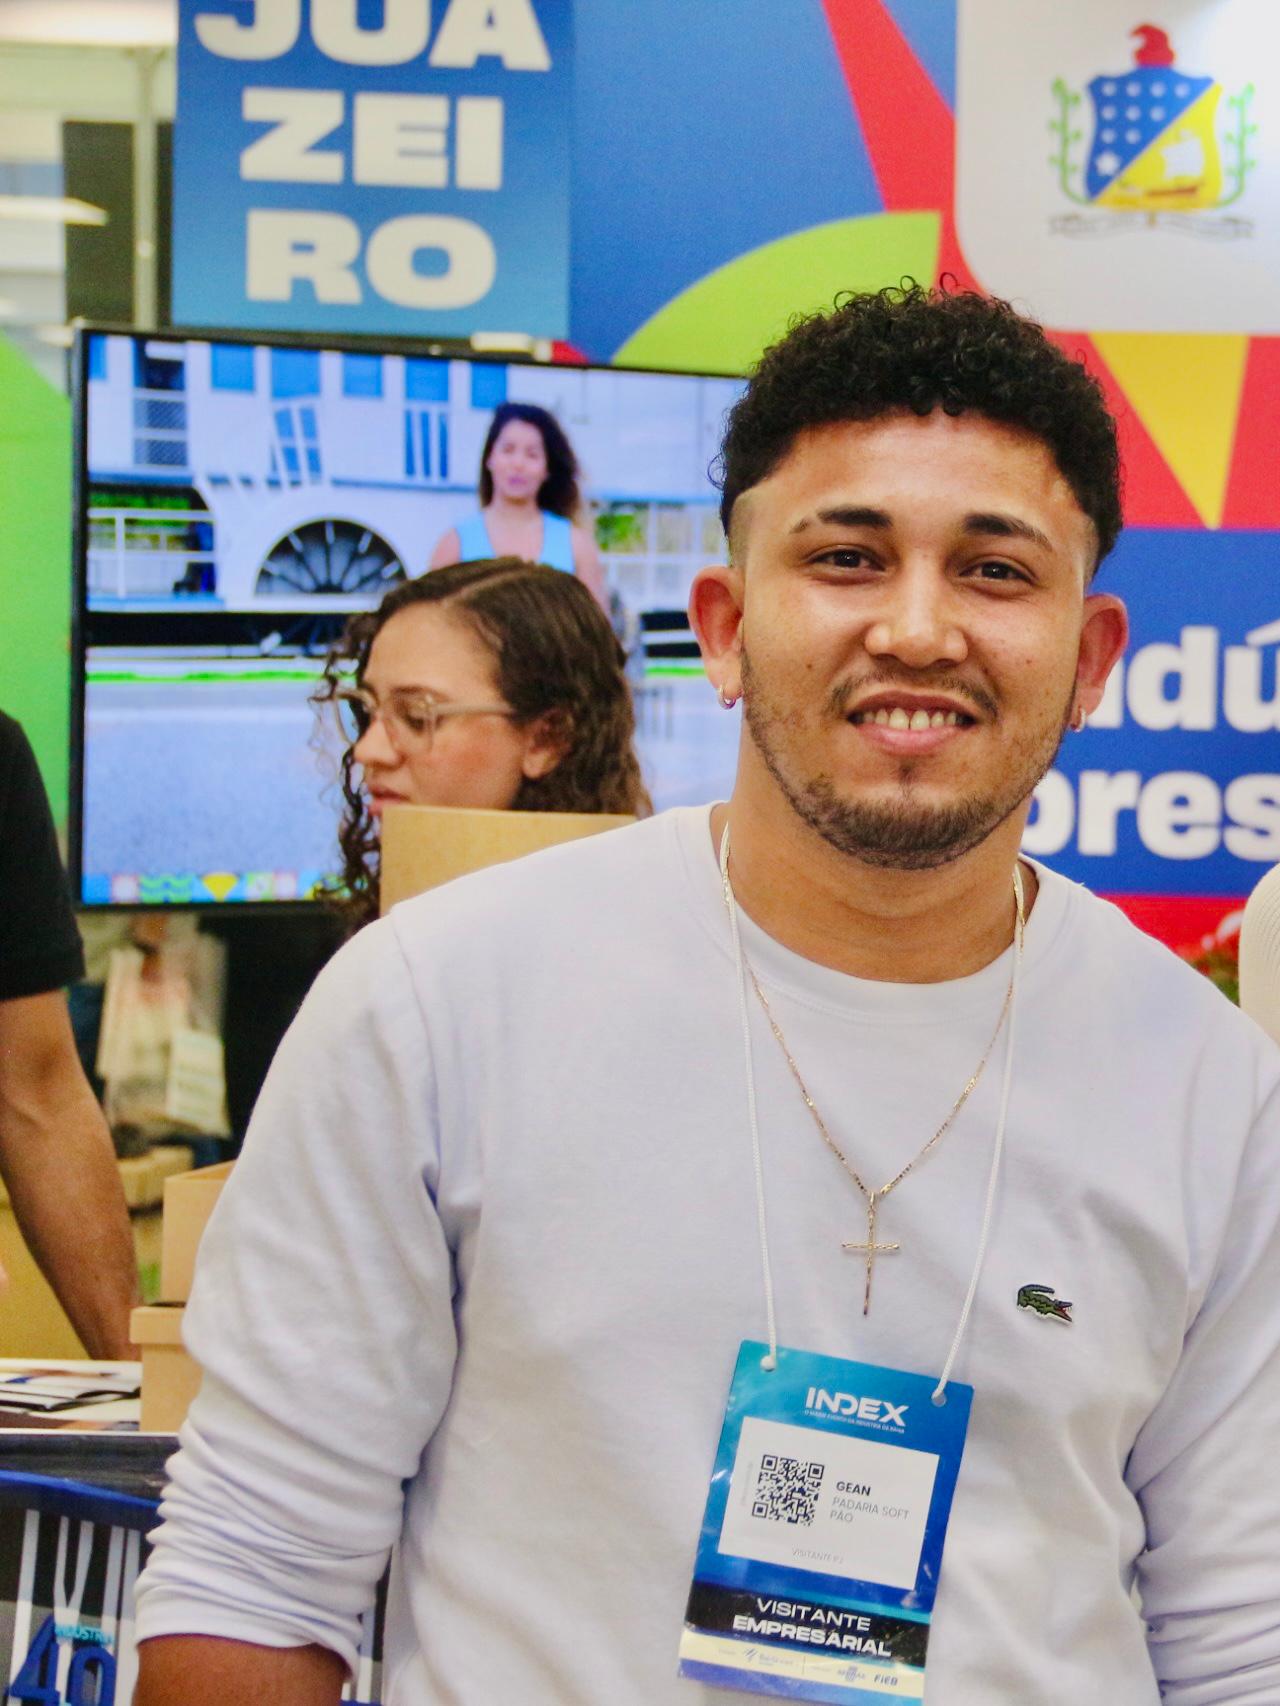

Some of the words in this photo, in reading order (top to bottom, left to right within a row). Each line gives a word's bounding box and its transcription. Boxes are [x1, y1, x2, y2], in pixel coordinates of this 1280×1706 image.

[195, 0, 552, 71] JUA
[240, 86, 503, 191] ZEI
[246, 208, 496, 311] RO
[805, 1386, 909, 1427] INDEX
[832, 1497, 878, 1515] PADARIA
[882, 1506, 909, 1520] SOFT
[836, 1481, 871, 1497] GEAN
[733, 1614, 892, 1657] EMPRESARIAL
[757, 1597, 872, 1632] VISITANTE
